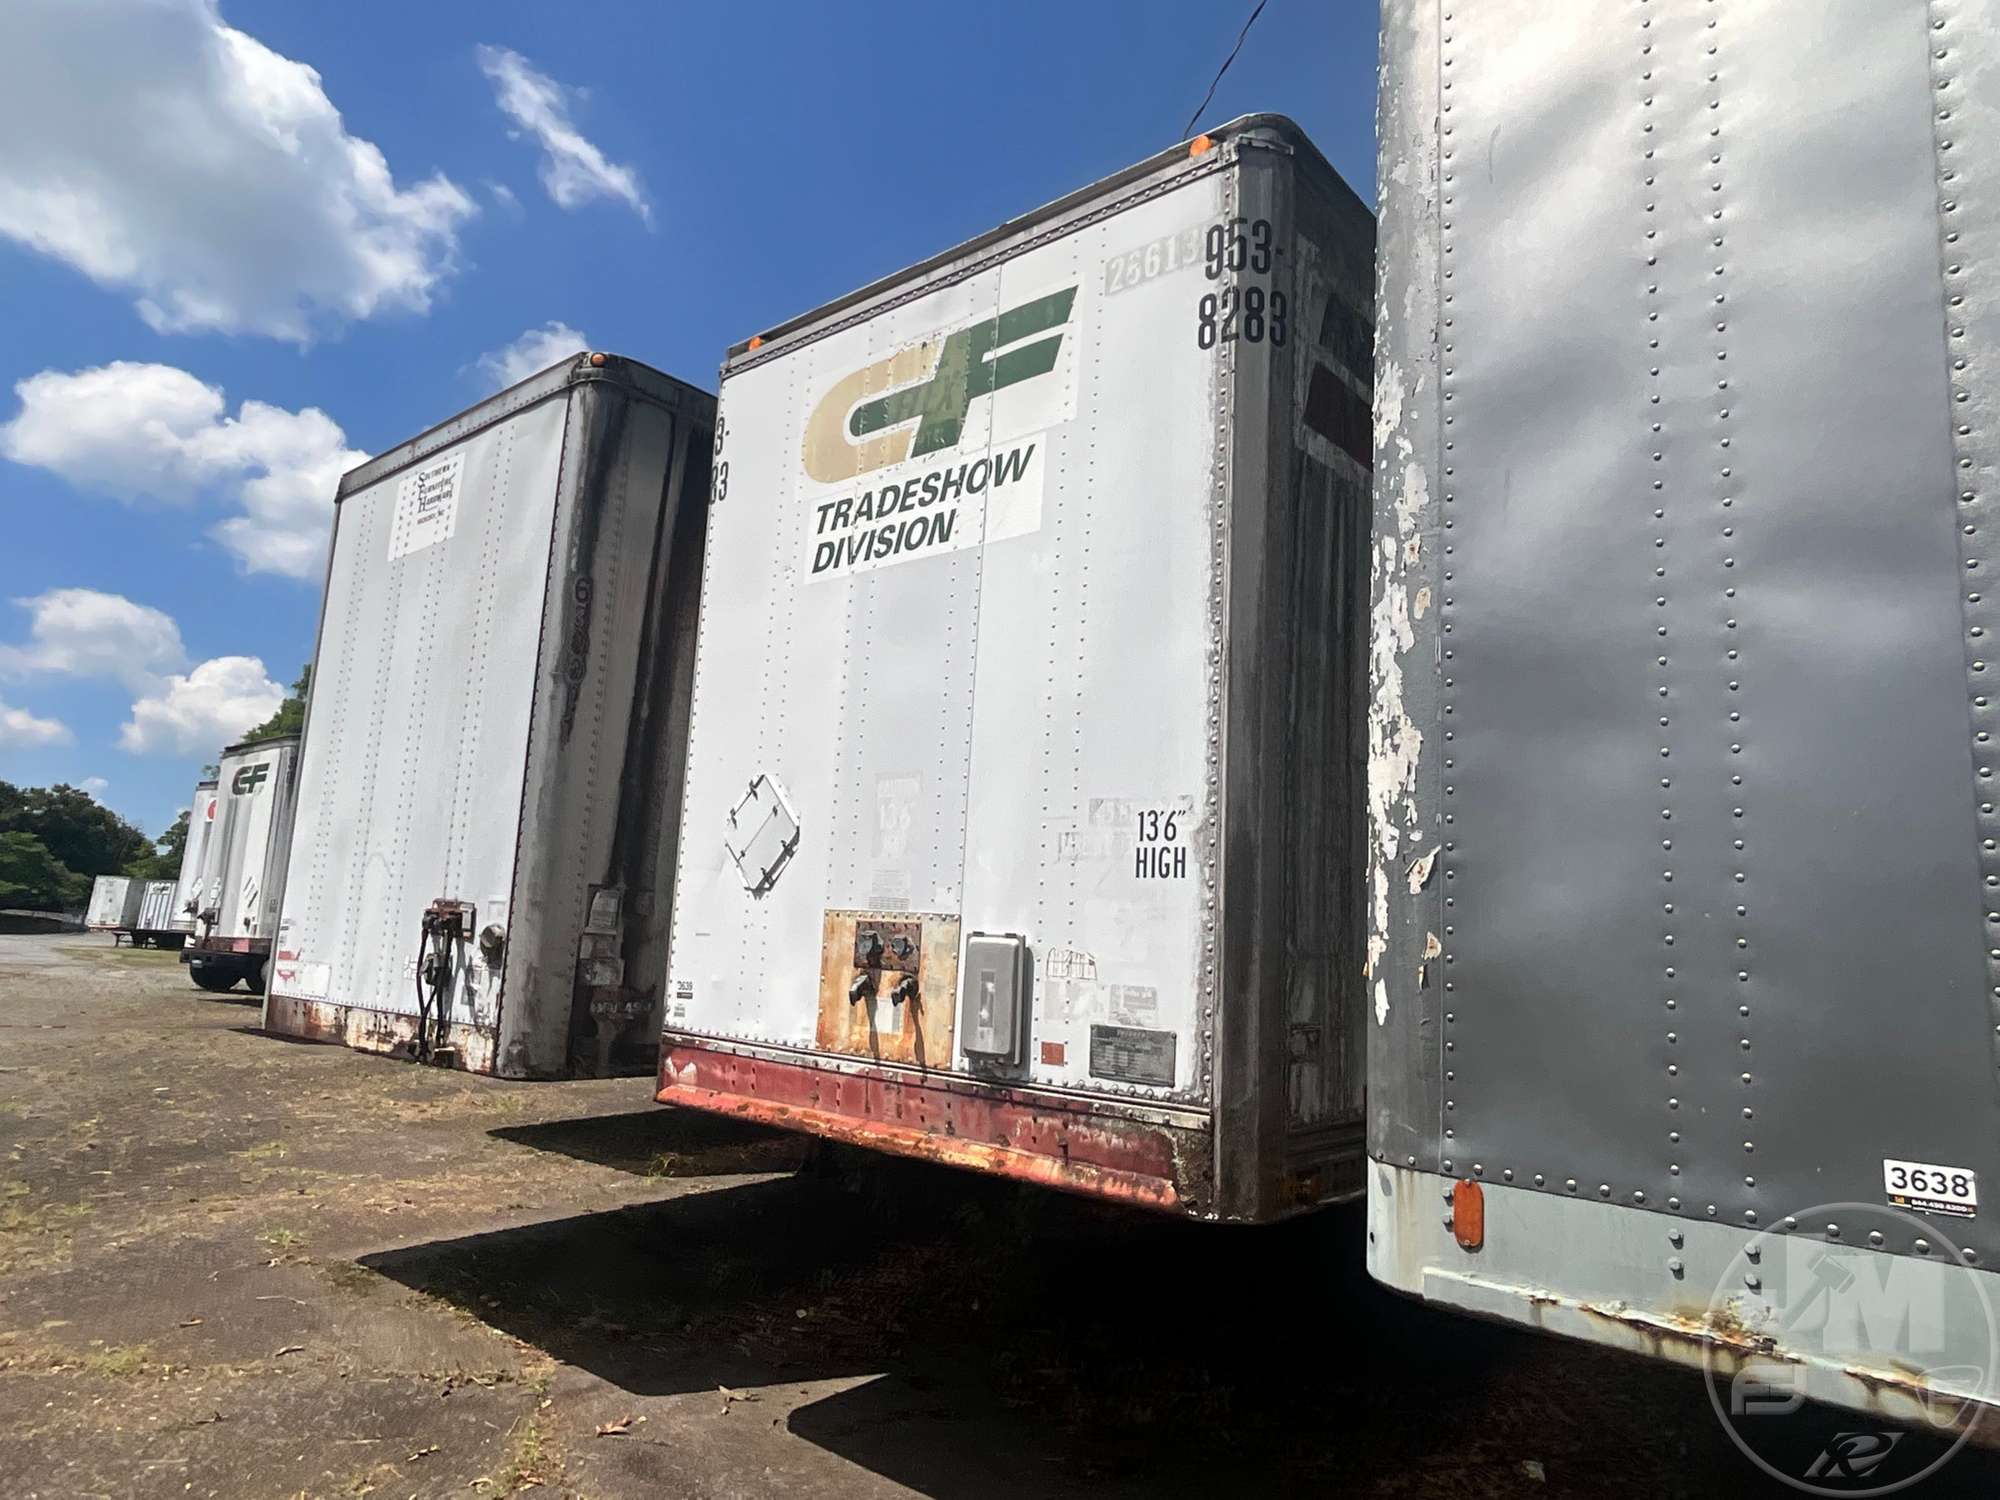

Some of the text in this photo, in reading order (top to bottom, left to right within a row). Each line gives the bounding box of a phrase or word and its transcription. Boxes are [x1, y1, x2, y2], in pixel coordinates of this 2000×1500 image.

[1198, 286, 1287, 350] 8283
[816, 443, 1036, 535] TRADESHOW
[811, 508, 957, 574] DIVISION
[232, 762, 270, 795] CF
[1135, 846, 1186, 879] HIGH
[1891, 1166, 1969, 1197] 3638
